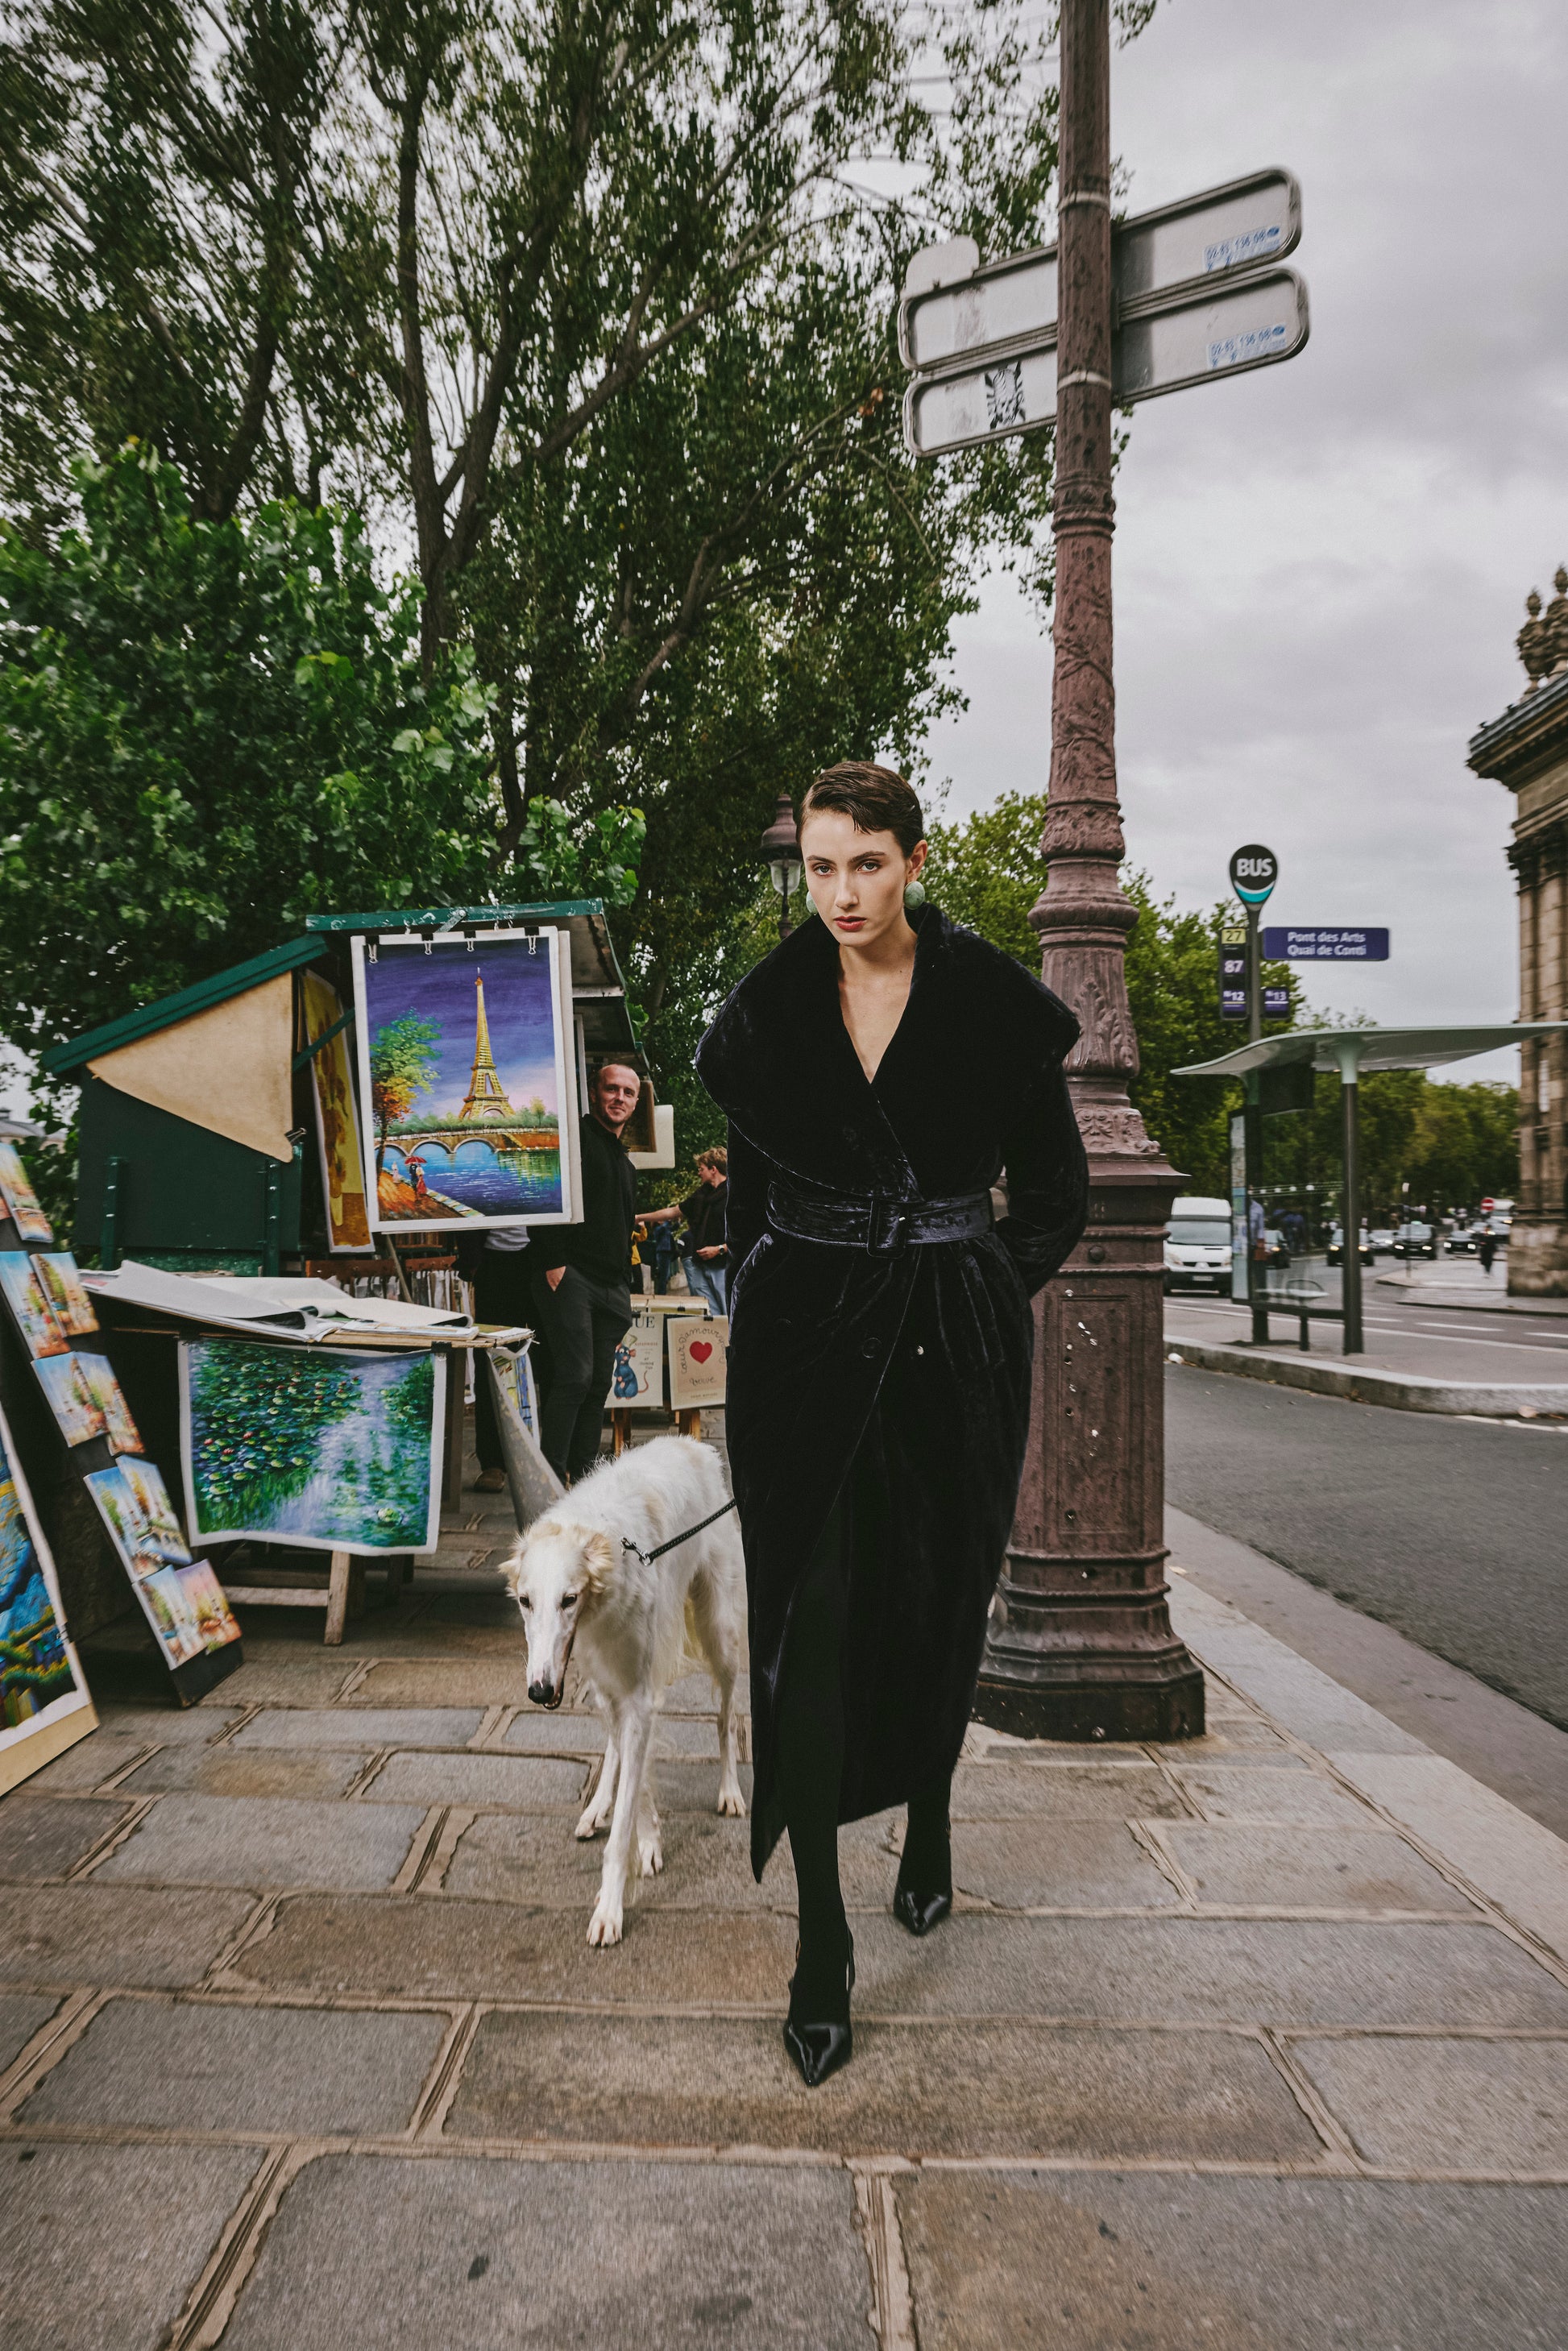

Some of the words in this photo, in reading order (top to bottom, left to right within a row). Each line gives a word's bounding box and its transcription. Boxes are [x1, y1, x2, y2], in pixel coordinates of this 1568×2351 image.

[1237, 858, 1273, 877] BUS
[1226, 931, 1242, 942] 27
[1288, 931, 1316, 942] Pont
[1317, 931, 1338, 942] des
[1339, 932, 1366, 942] Arts
[1287, 944, 1315, 956] Quai
[1317, 944, 1333, 956] de
[1334, 944, 1367, 956] Conti
[1224, 960, 1244, 973] 87
[634, 1316, 655, 1328] UE
